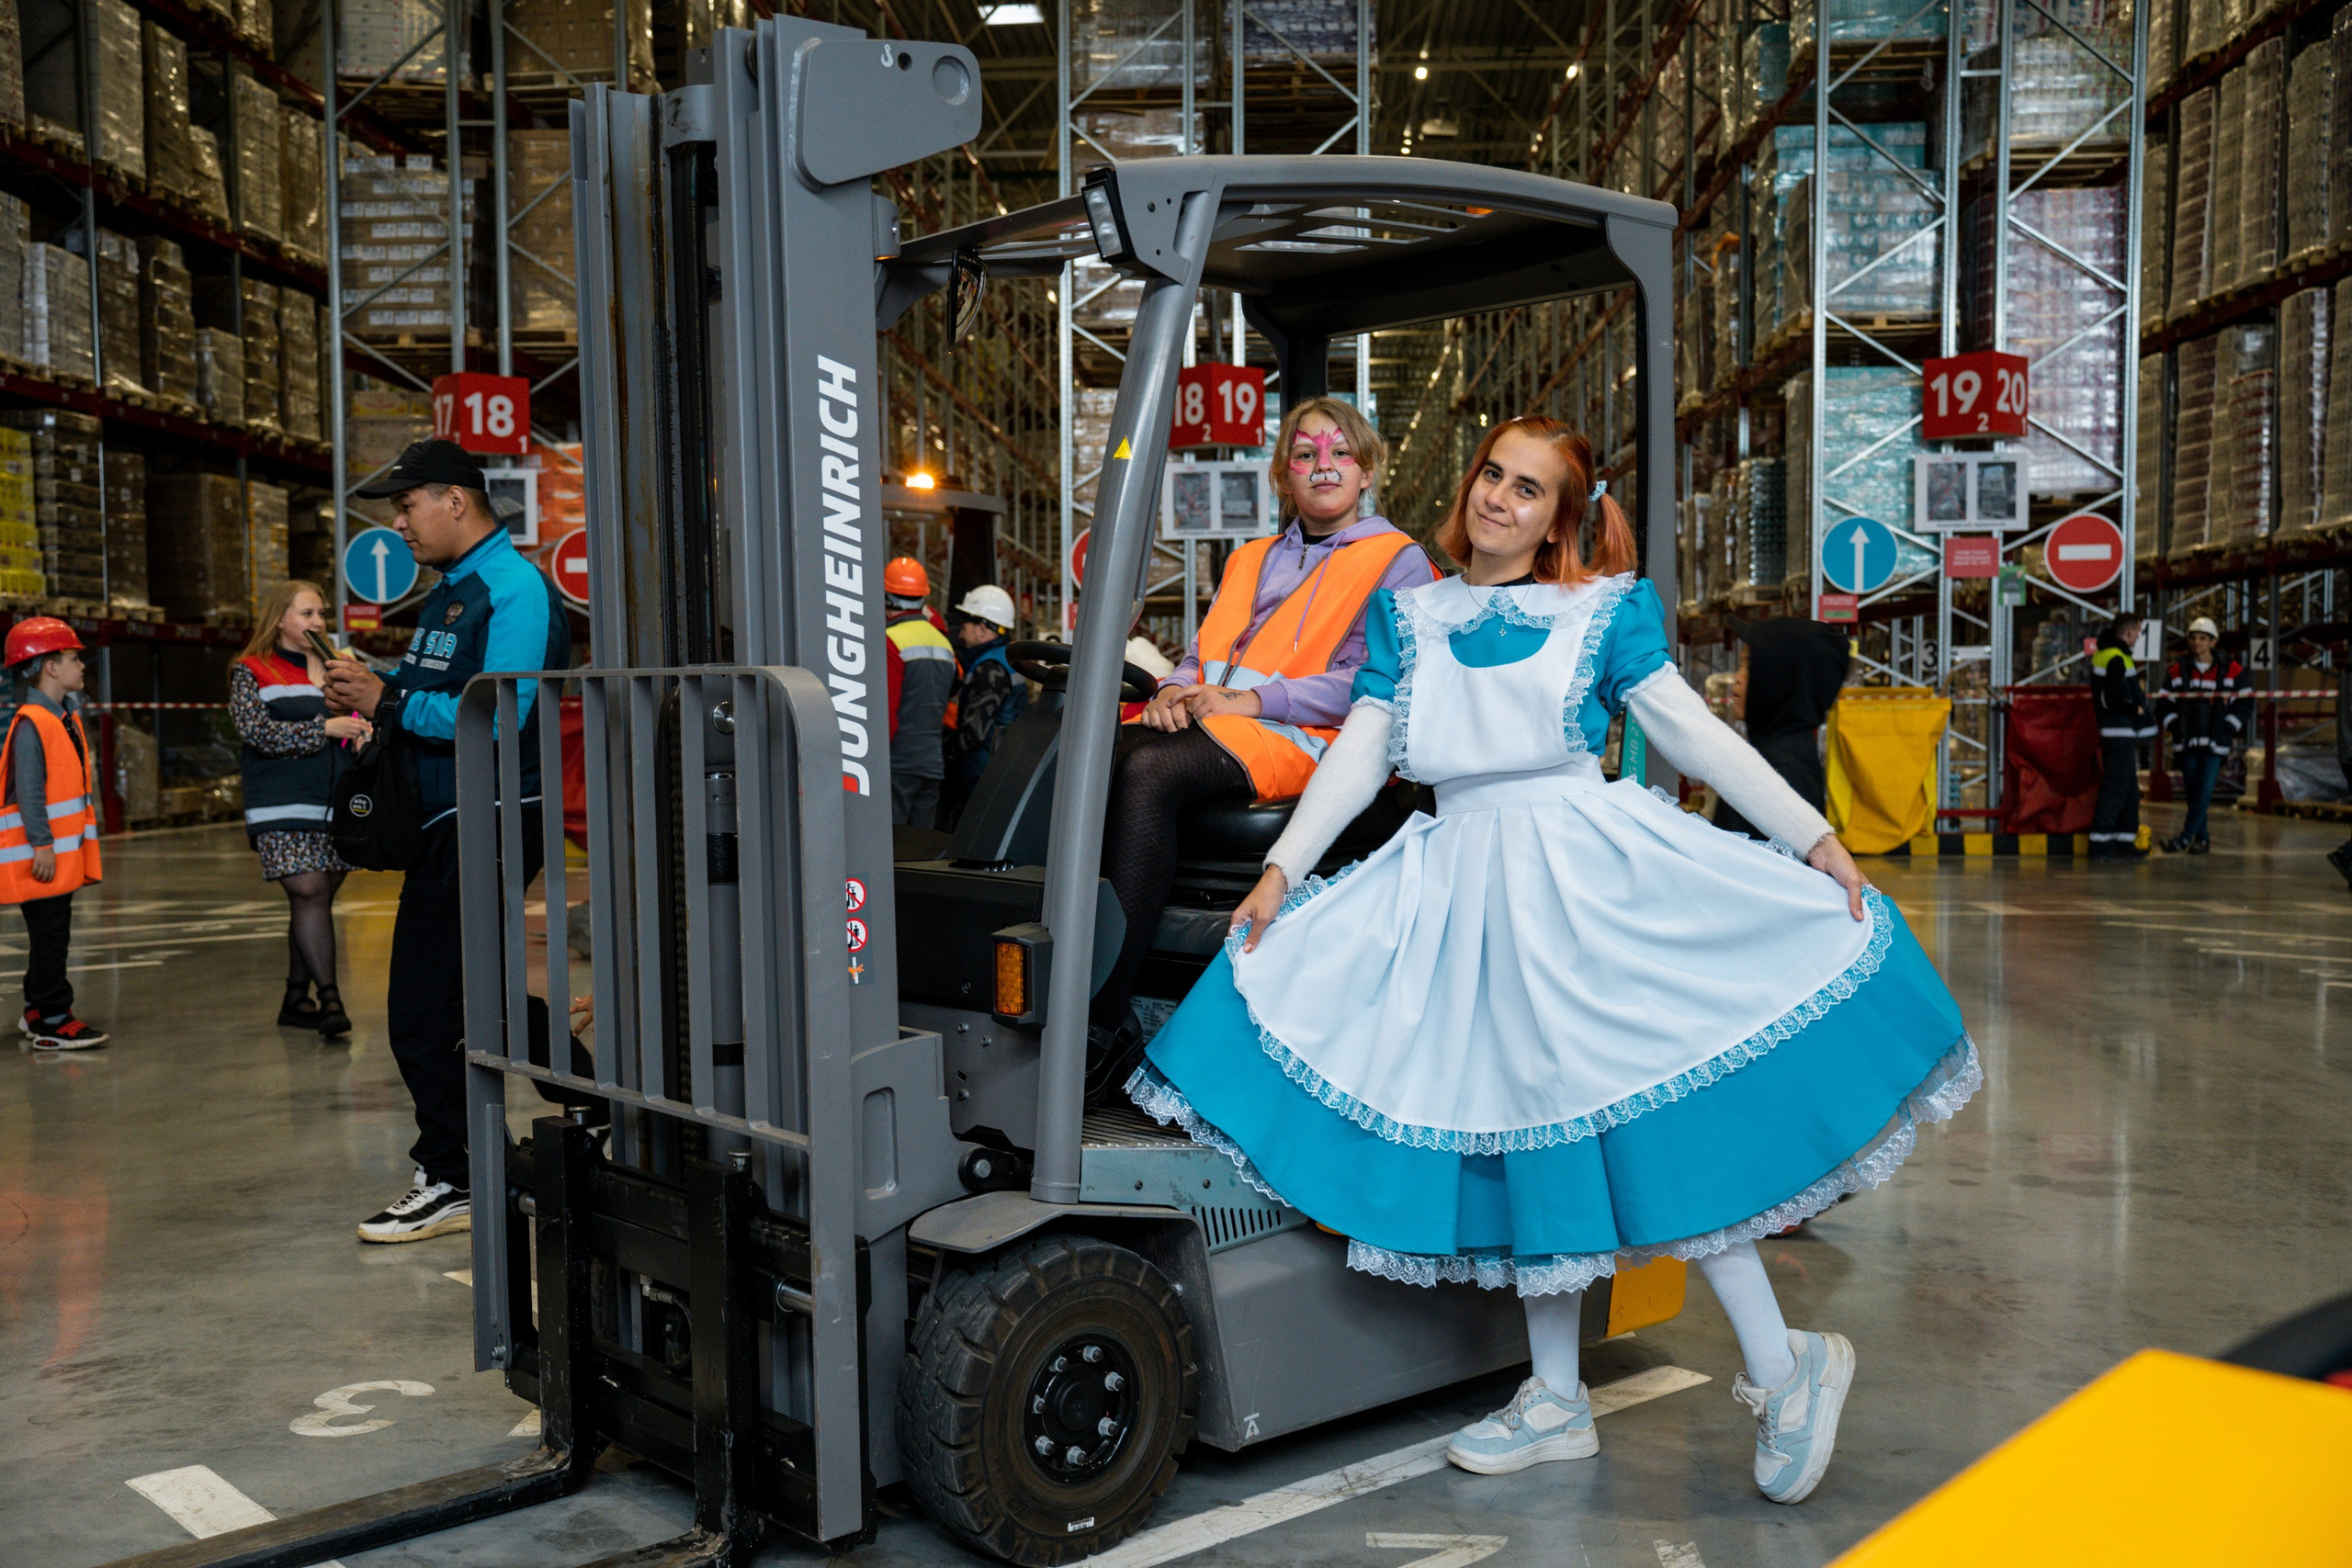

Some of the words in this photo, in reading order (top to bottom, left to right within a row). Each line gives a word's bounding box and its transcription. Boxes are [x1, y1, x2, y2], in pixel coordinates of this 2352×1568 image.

[1174, 381, 1205, 428] 18
[1217, 379, 1258, 425] 19
[1930, 369, 1983, 418] 19
[1996, 368, 2027, 416] 20
[433, 393, 454, 437] 17
[463, 391, 515, 438] 18
[1976, 412, 1990, 433] 2
[2021, 416, 2027, 436] 1
[518, 434, 528, 454] 1
[1202, 423, 1212, 443] 2
[1255, 426, 1263, 446] 1
[817, 354, 871, 797] JUNGHEINRICH
[1923, 642, 1939, 668] 3
[2254, 640, 2270, 668] 4
